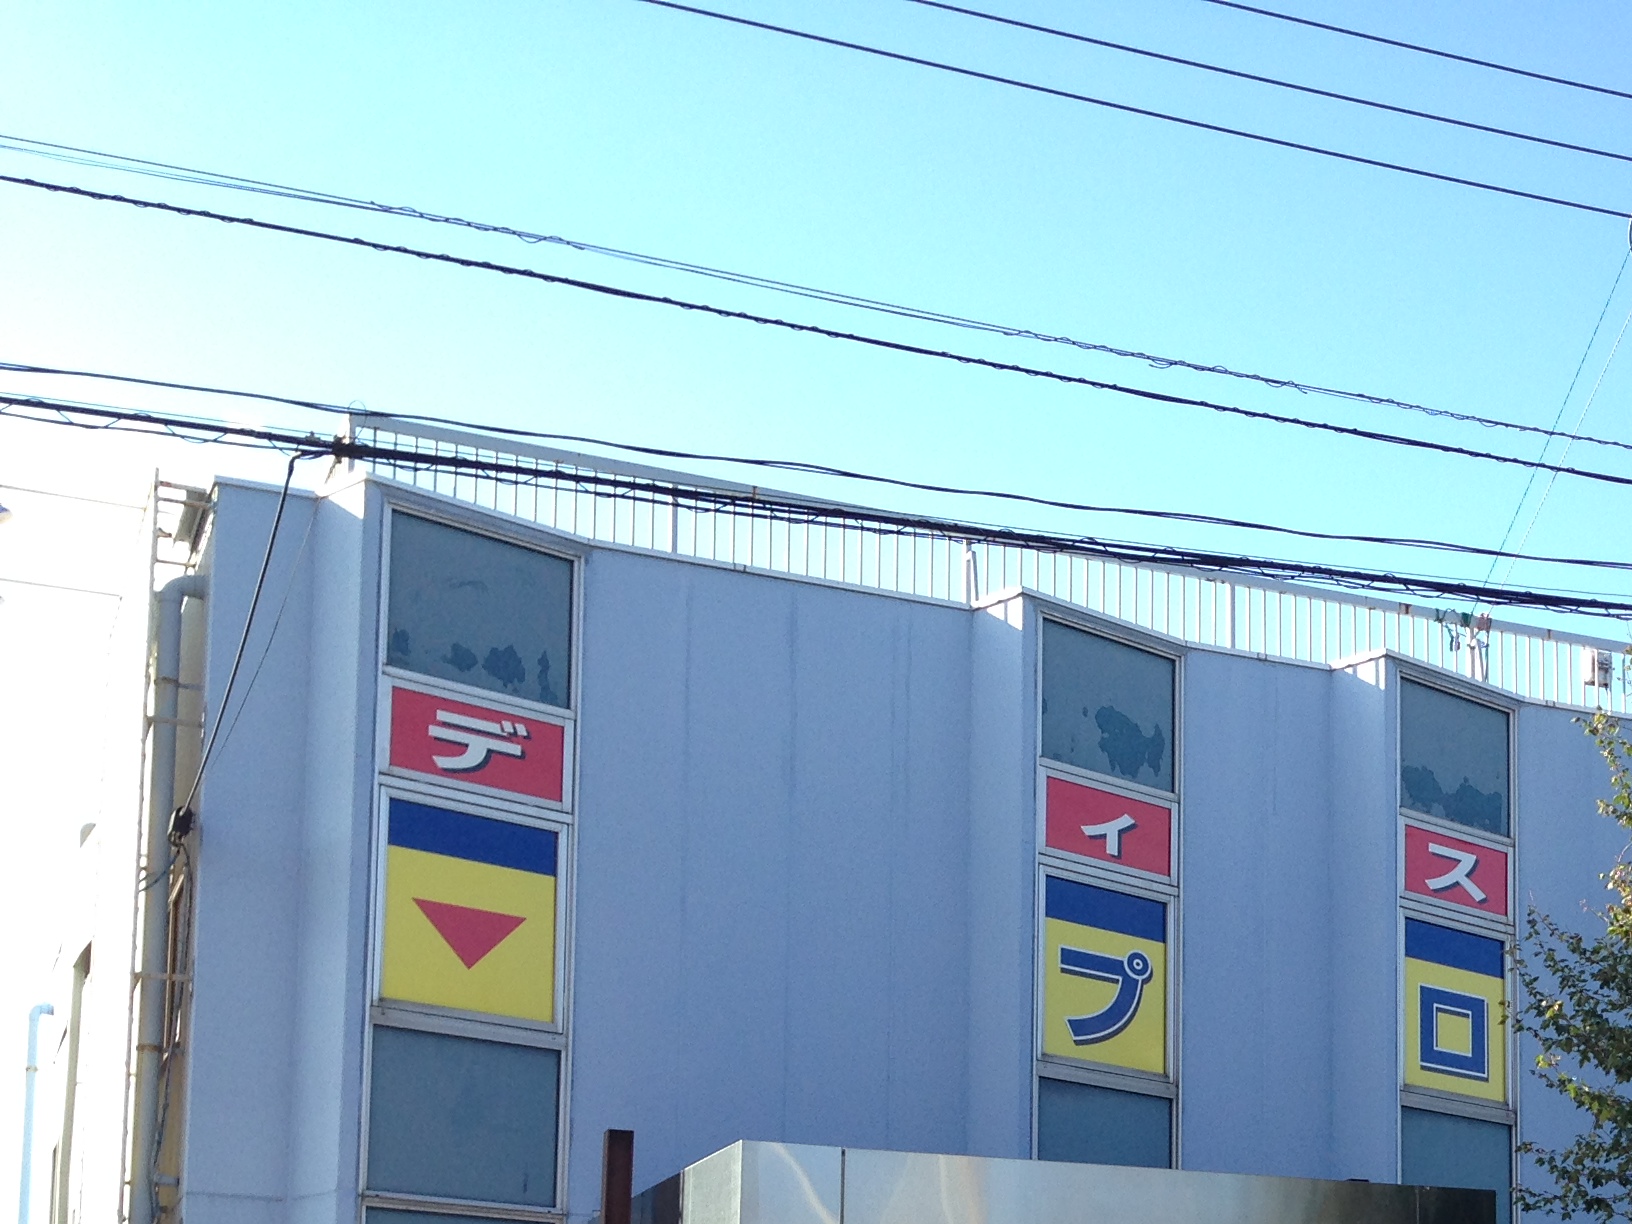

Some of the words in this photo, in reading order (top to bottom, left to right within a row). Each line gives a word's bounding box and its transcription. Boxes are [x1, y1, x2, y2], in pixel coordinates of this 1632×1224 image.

[428, 708, 530, 772] デ
[1425, 842, 1487, 903] ス
[1058, 944, 1152, 1045] プ
